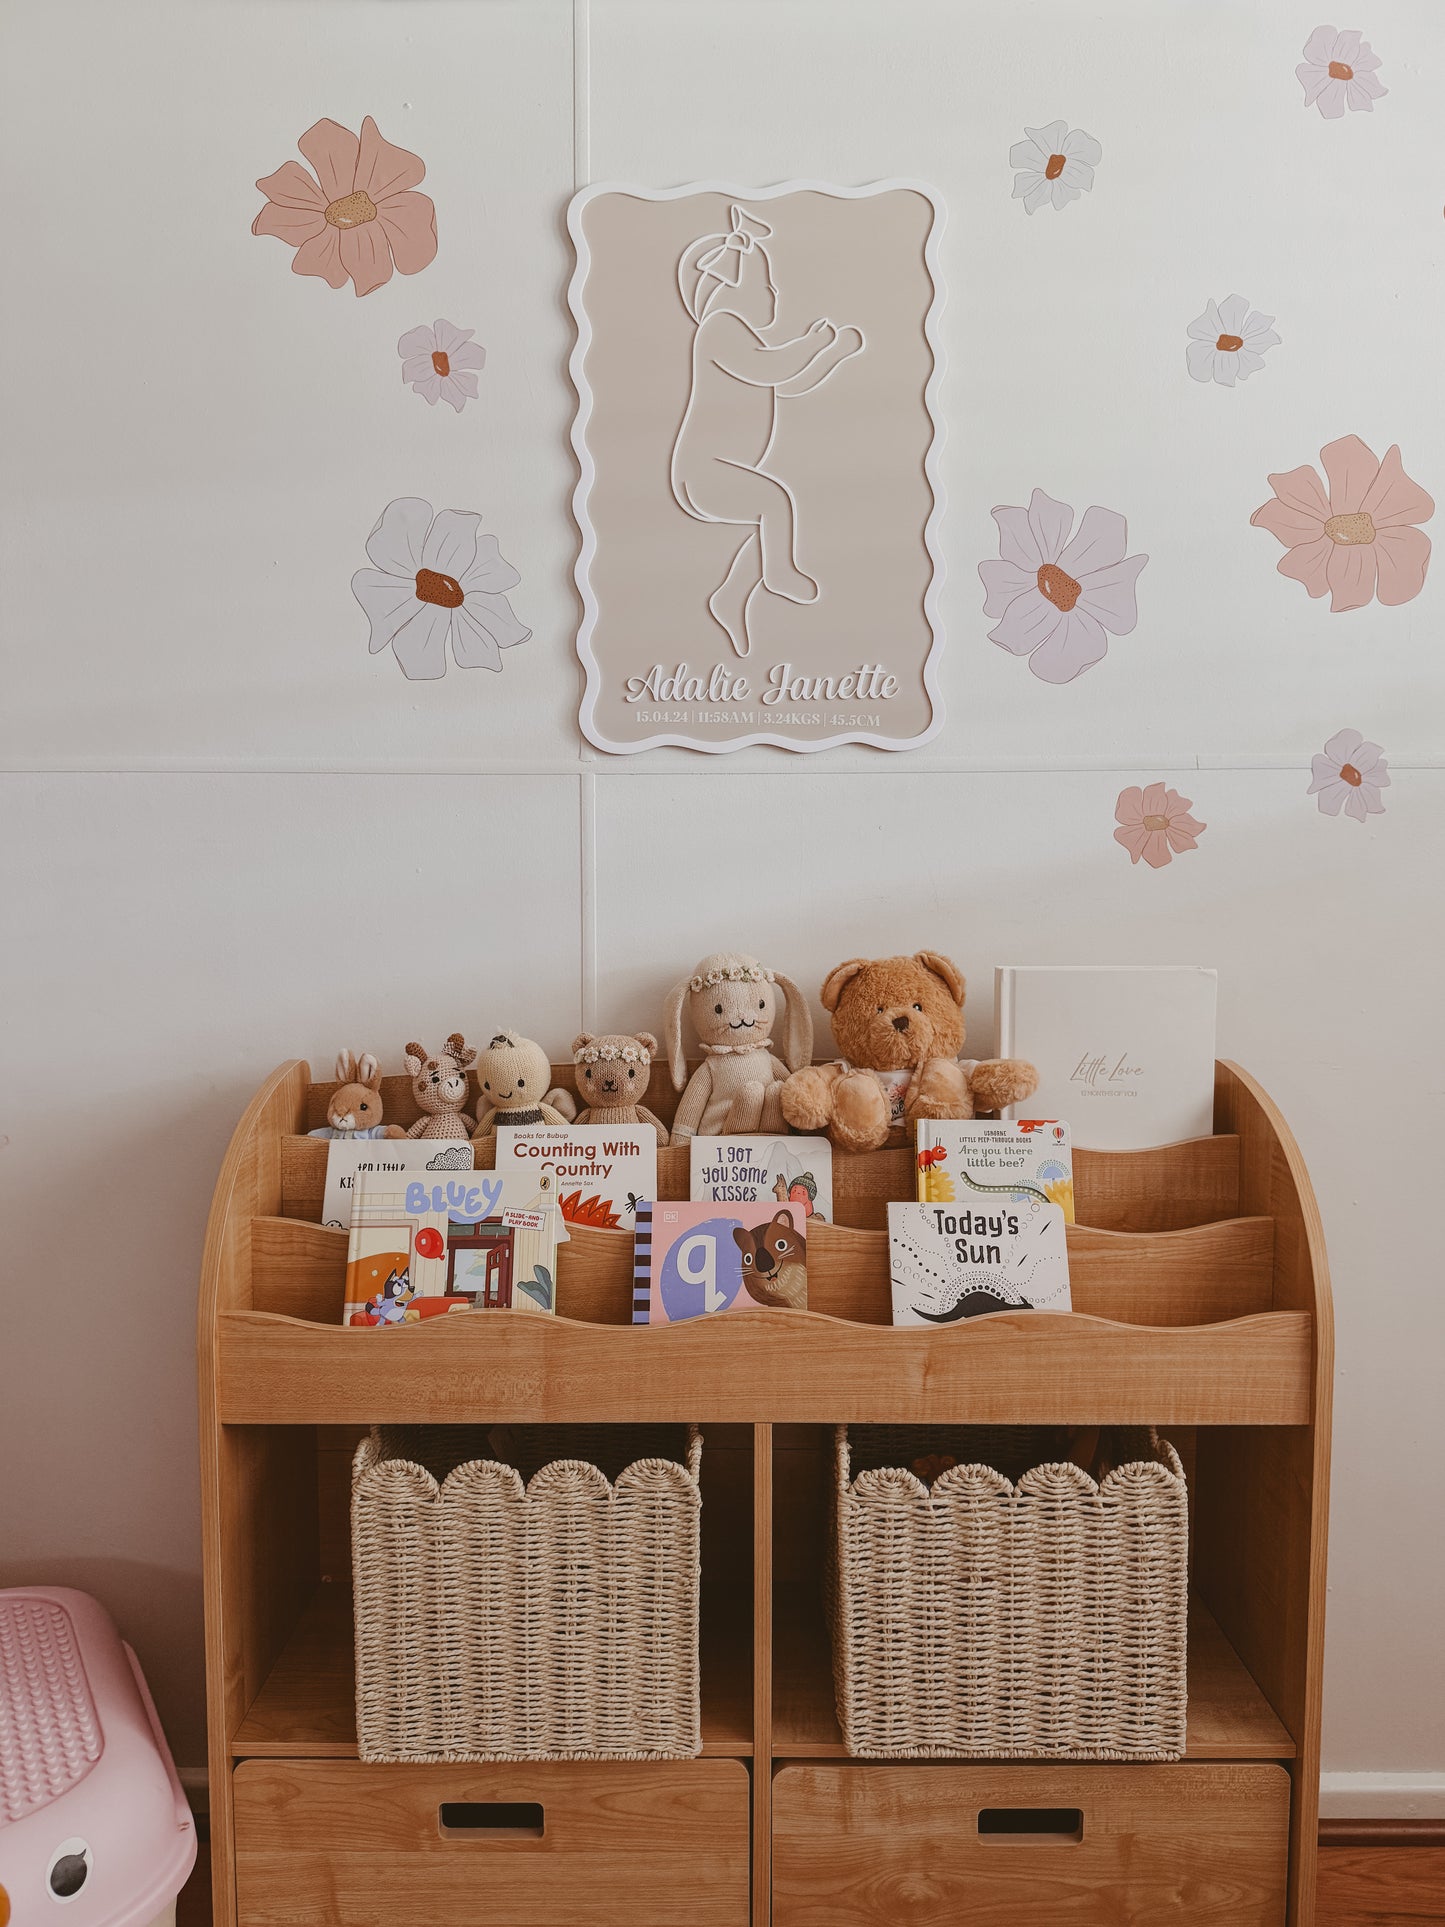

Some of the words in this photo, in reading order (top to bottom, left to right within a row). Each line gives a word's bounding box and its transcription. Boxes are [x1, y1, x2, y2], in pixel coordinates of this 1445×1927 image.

[625, 663, 751, 703] Adalie
[762, 663, 900, 705] Janette
[635, 711, 688, 723] 15.04.24
[698, 711, 754, 724] 11:58AM
[763, 712, 820, 725] 3.24KGS
[830, 714, 880, 726] 45.5CM
[1108, 1052, 1144, 1081] Love
[546, 1132, 568, 1140] Bubup
[513, 1142, 597, 1160] Counting
[602, 1141, 640, 1156] With
[716, 1147, 723, 1163] I
[959, 1145, 978, 1155] Are
[981, 1148, 1001, 1158] you
[1004, 1146, 1033, 1155] there
[967, 1158, 996, 1168] little
[999, 1157, 1025, 1168] bee?
[405, 1178, 504, 1225] BLUEY
[933, 1209, 1019, 1238] Today's
[955, 1238, 1001, 1264] Sun
[677, 1235, 728, 1313] q
